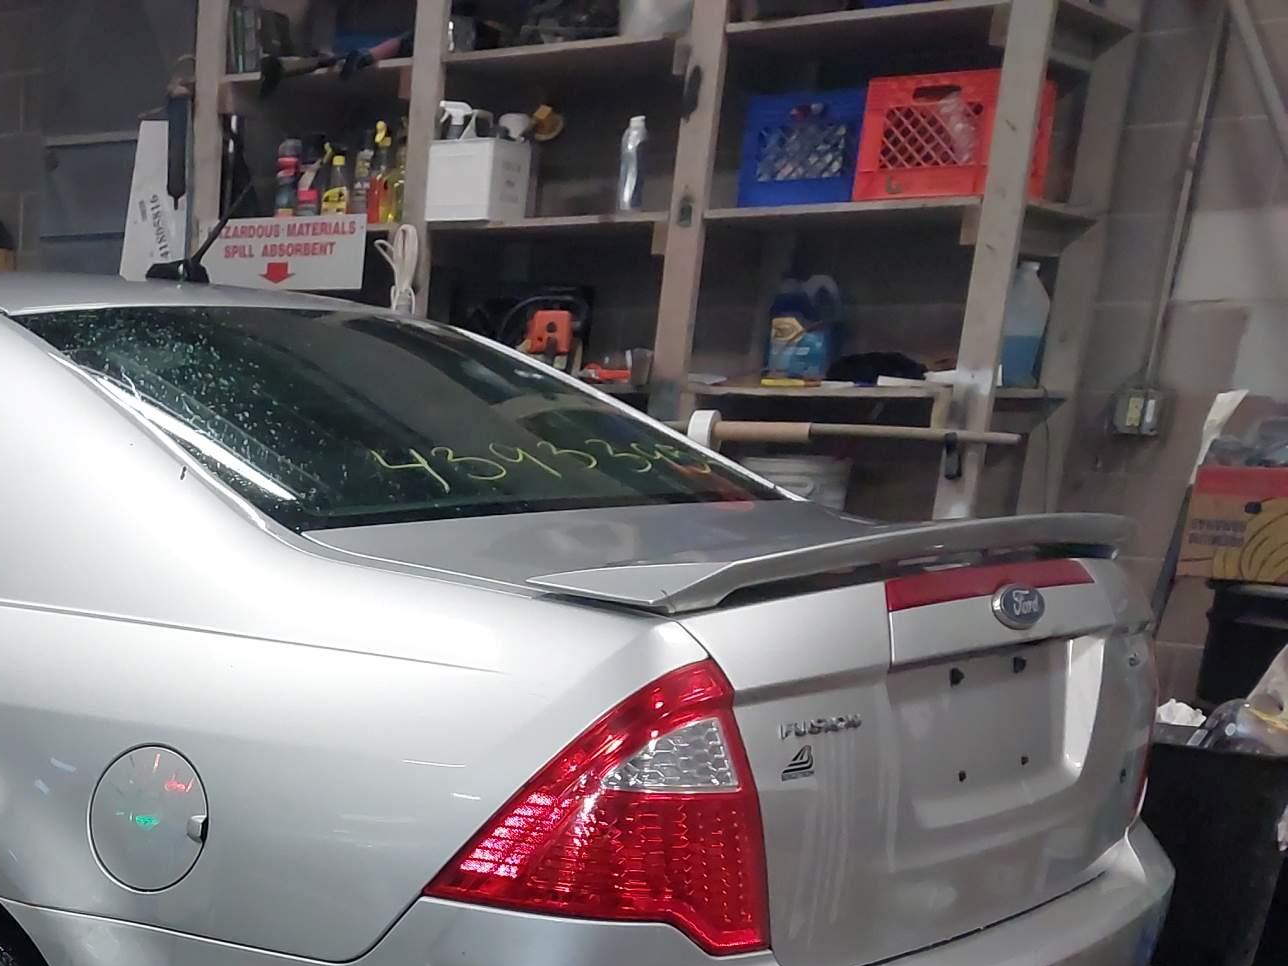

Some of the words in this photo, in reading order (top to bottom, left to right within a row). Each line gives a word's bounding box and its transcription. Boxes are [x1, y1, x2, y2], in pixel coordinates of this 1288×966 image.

[286, 220, 357, 239] MATERIALS
[223, 245, 255, 259] SPILL
[262, 241, 337, 258] ABSORBENT
[1012, 590, 1039, 616] Ford
[777, 713, 862, 740] FUSION
